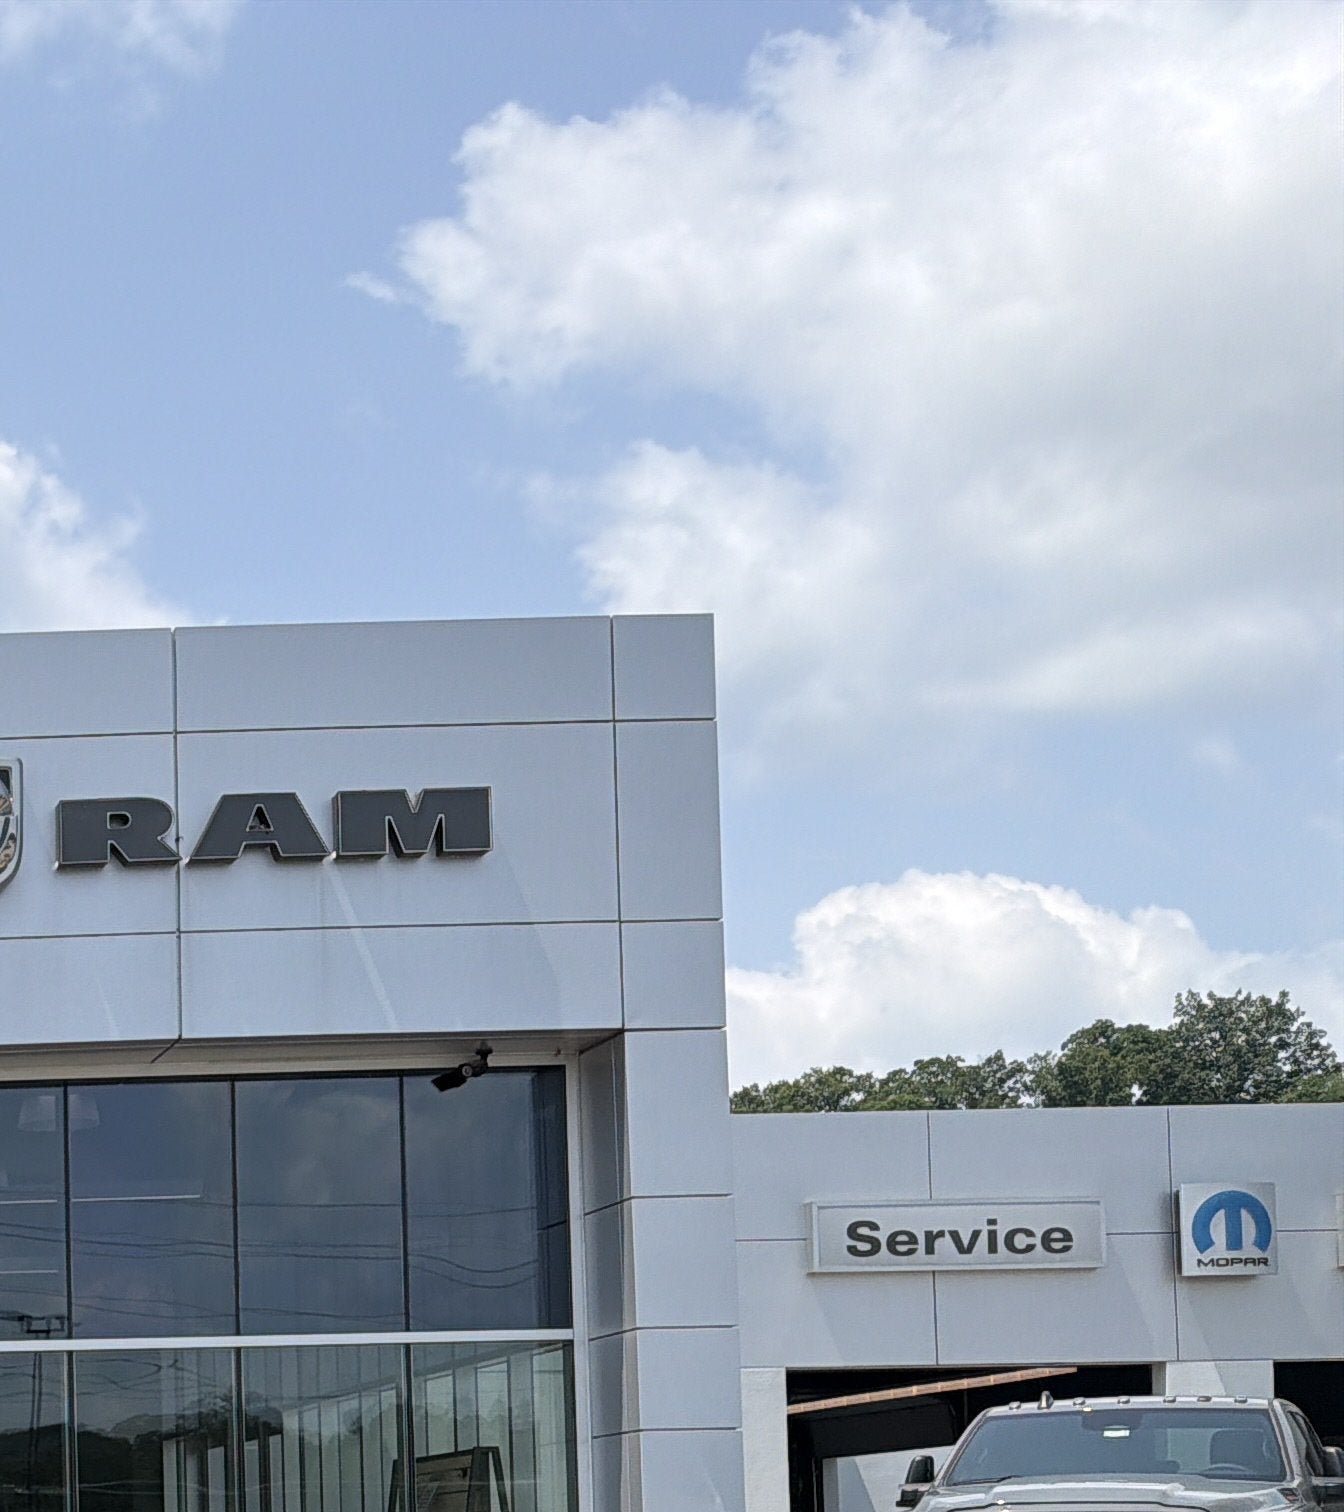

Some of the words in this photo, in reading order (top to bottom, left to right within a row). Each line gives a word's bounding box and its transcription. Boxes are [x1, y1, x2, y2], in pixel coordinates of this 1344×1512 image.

[55, 785, 493, 866] RAM
[845, 1218, 1075, 1259] Service
[1196, 1256, 1270, 1269] MOPAR
